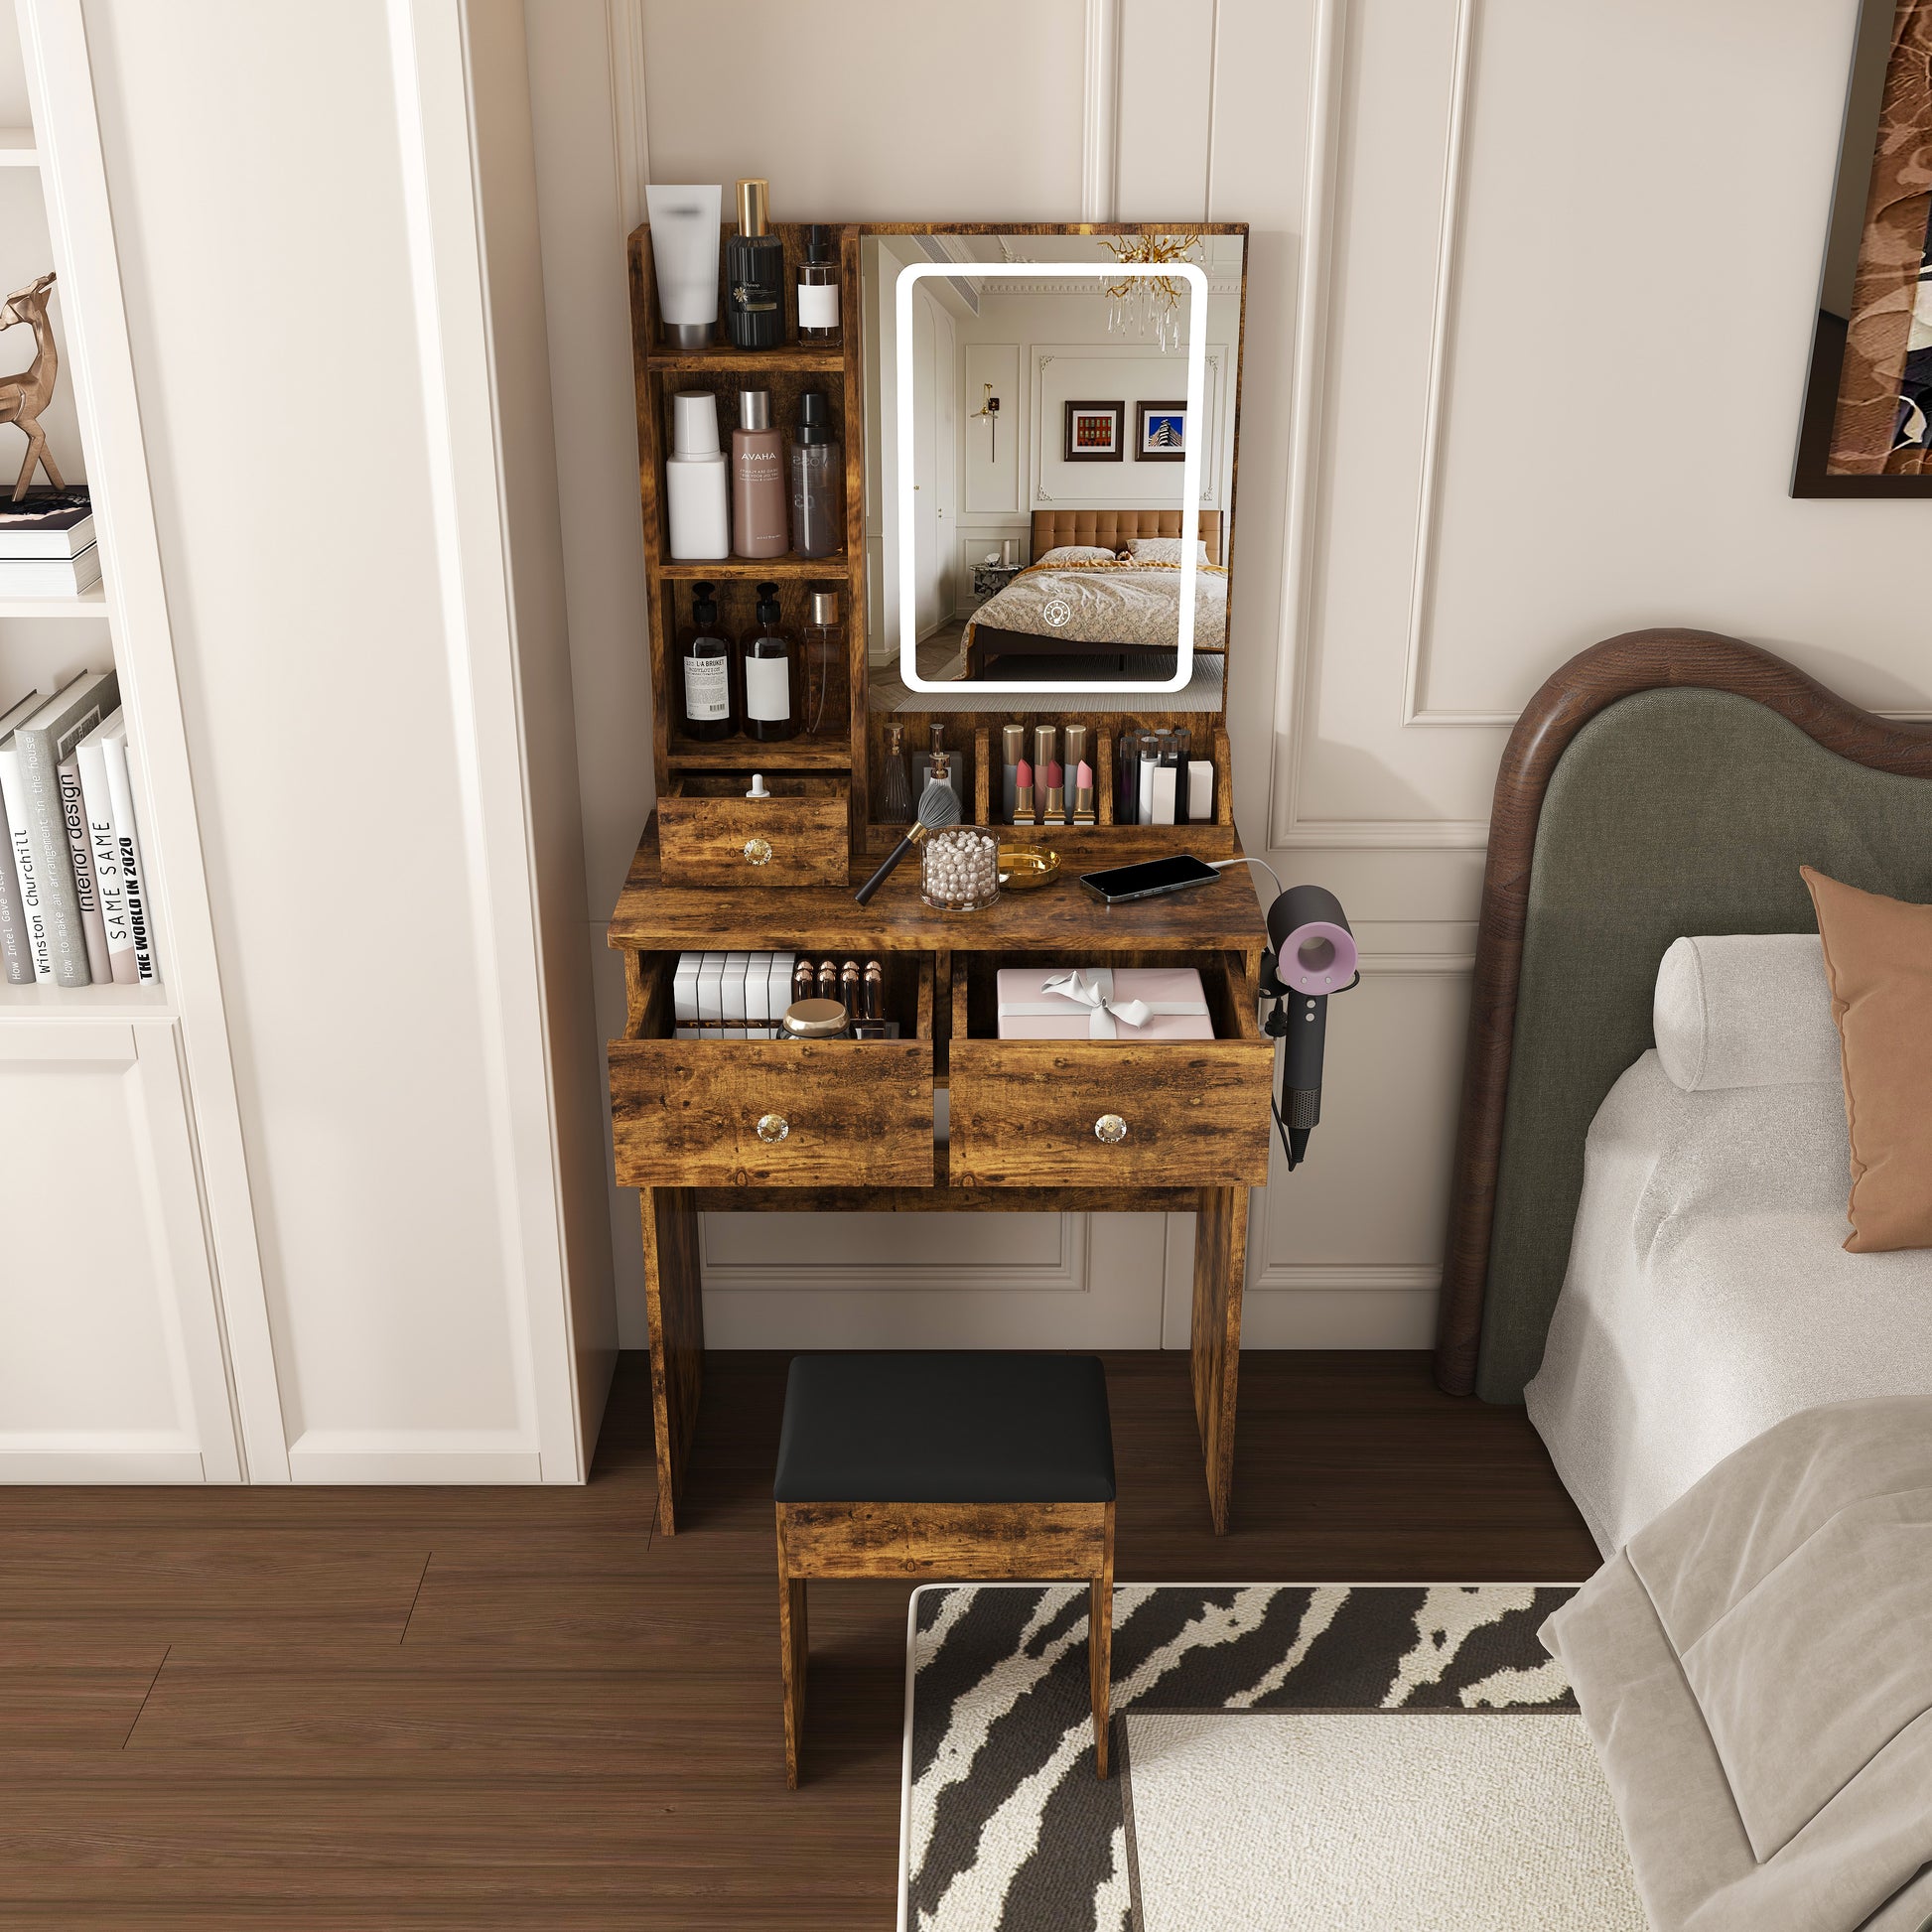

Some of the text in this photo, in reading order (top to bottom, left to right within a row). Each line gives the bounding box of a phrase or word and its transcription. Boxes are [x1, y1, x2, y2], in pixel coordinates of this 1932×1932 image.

[741, 452, 776, 461] AVAHA
[25, 737, 74, 978] How to make an arrangement in the house
[61, 773, 95, 912] Interior design
[92, 822, 127, 939] SAME SAME
[0, 898, 11, 922] Gave
[3, 927, 17, 956] Intel
[14, 829, 51, 974] Winston Churchill
[119, 837, 153, 980] THE WORLD IN 2020
[12, 961, 21, 980] How
